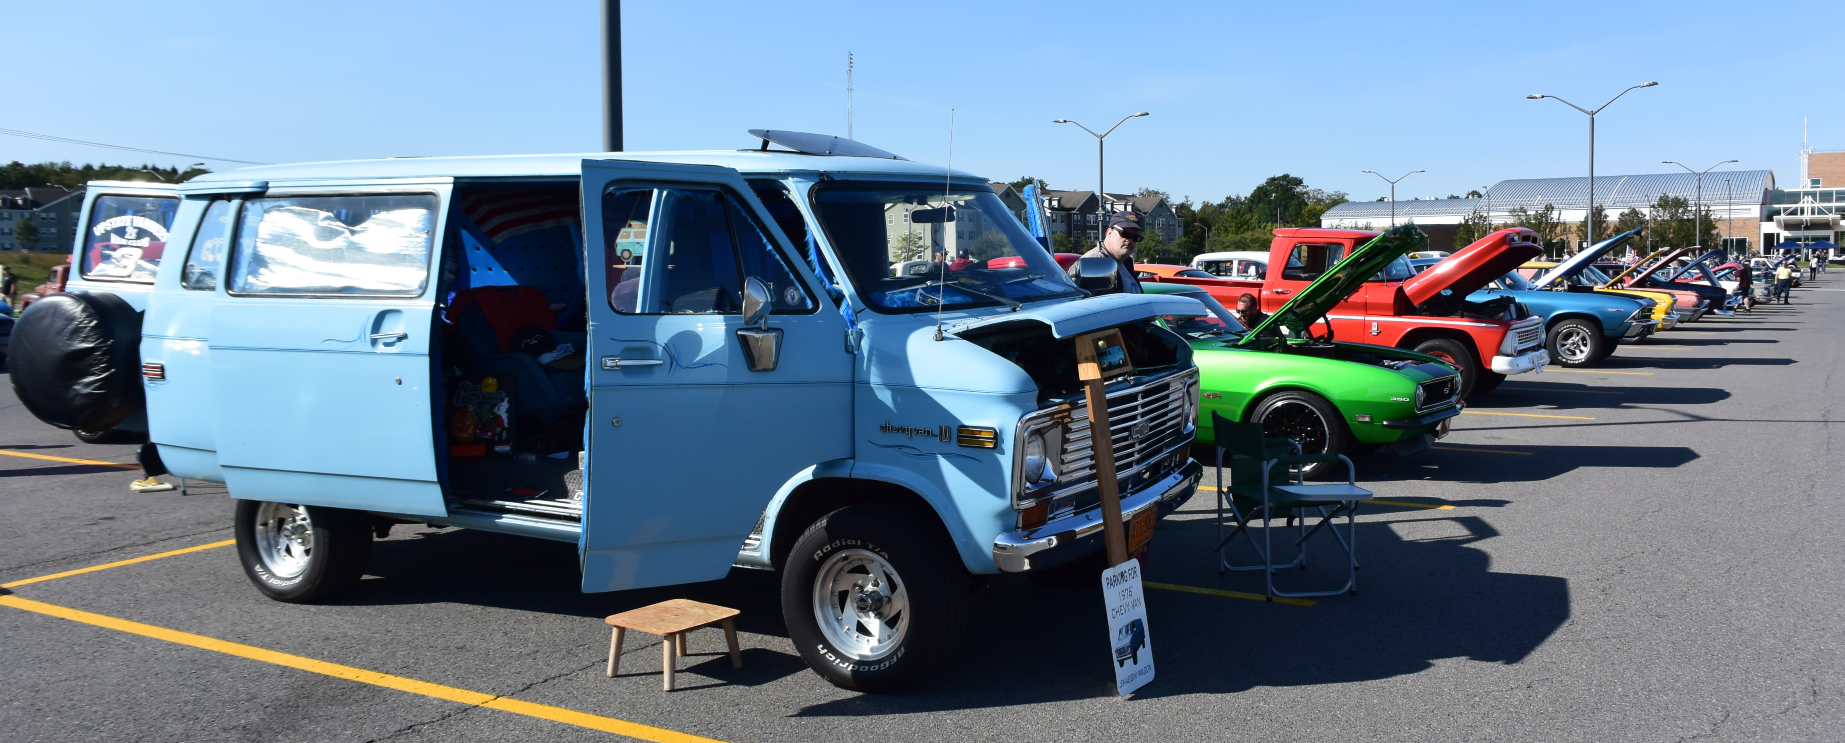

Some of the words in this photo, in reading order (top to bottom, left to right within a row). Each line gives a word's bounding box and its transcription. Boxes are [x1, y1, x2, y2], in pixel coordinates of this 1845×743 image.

[93, 215, 132, 236] UPSTATE
[110, 233, 127, 245] VAN
[128, 237, 150, 247] CLUB
[813, 539, 861, 561] Radial
[867, 542, 889, 560] T/A
[254, 564, 269, 580] T/A
[1105, 570, 1128, 590] PARKING
[1128, 565, 1139, 580] FOR
[1111, 603, 1130, 619] CHEVY
[1130, 597, 1142, 609] VAN
[817, 643, 906, 672] BFGoodrich
